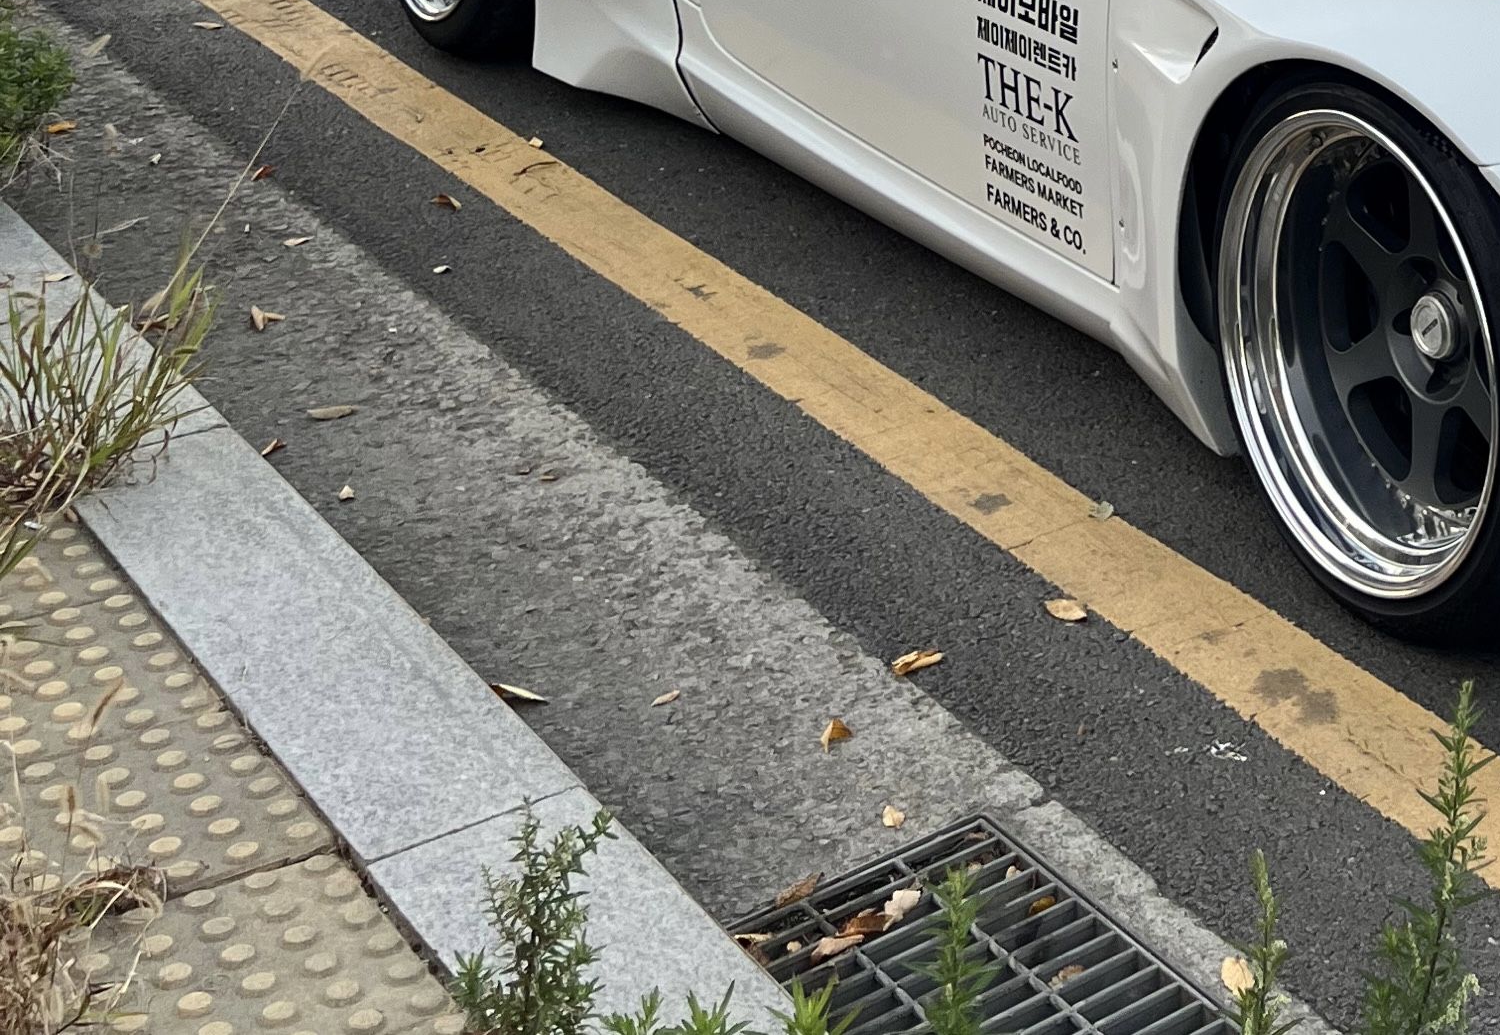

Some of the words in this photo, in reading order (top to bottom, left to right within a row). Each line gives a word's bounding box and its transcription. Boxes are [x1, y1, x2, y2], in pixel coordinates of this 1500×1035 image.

[976, 15, 1077, 82] 제이제이렌트카
[977, 52, 1080, 144] THE-K
[983, 103, 1017, 133] AUTO
[1021, 122, 1082, 166] SERVICE
[983, 133, 1026, 167] POCHEON
[1026, 156, 1082, 195] LOCALFOOD
[985, 154, 1036, 194] FARMERS
[1037, 181, 1084, 219] MARKET
[986, 182, 1047, 232] FARMERS
[1050, 217, 1061, 241] &
[1063, 225, 1087, 255] CO.
